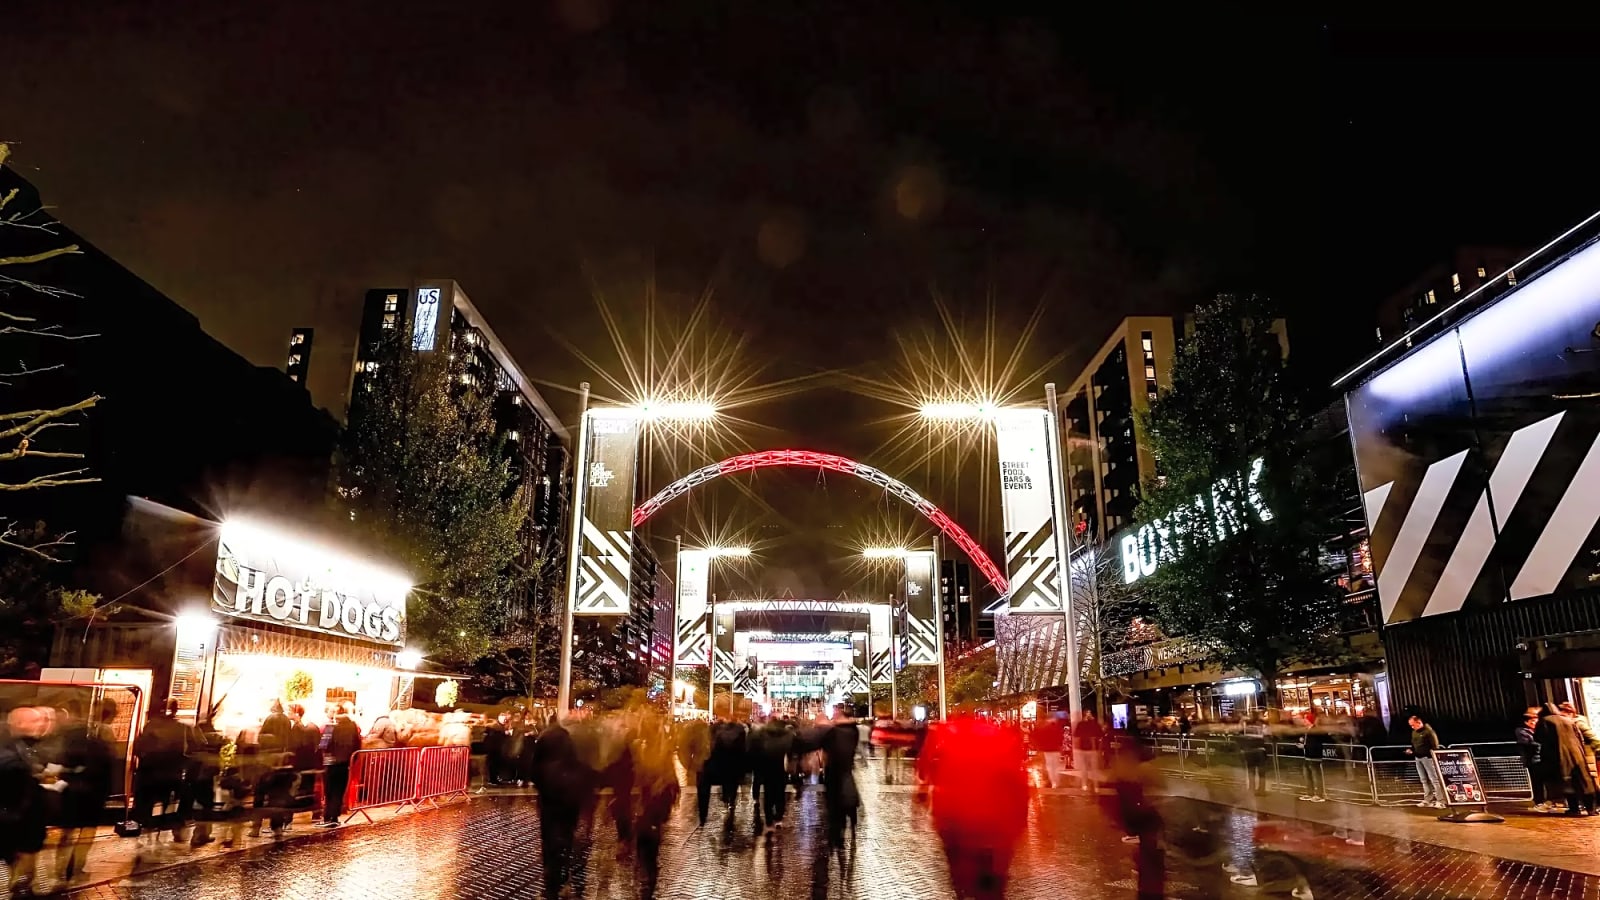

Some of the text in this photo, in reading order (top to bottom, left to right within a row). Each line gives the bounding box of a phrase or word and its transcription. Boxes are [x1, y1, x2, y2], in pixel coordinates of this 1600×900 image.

[590, 478, 608, 487] PLAY
[235, 565, 400, 641] HOT DOGS
[1322, 749, 1338, 757] ARK
